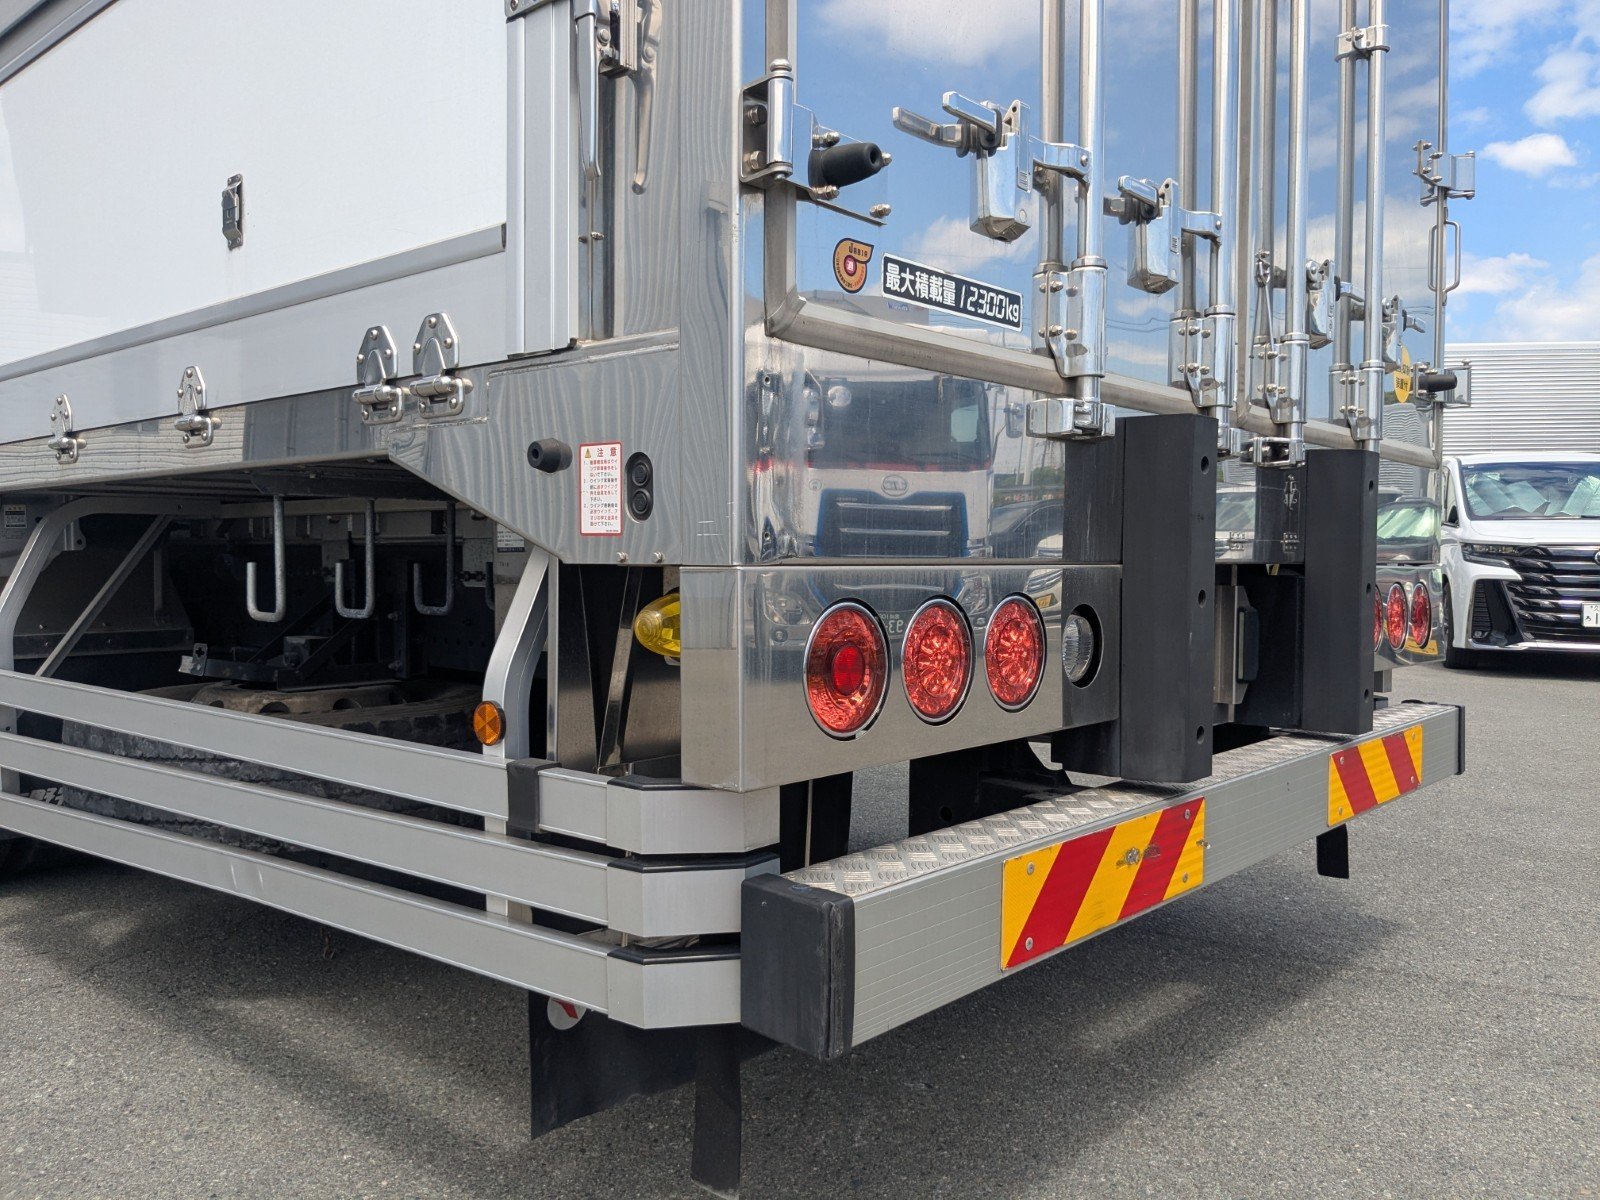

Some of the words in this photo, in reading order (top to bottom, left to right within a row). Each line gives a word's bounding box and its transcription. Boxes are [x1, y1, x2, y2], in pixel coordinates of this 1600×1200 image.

[885, 262, 956, 307] 最大積載量
[959, 284, 1020, 323] 12300kg
